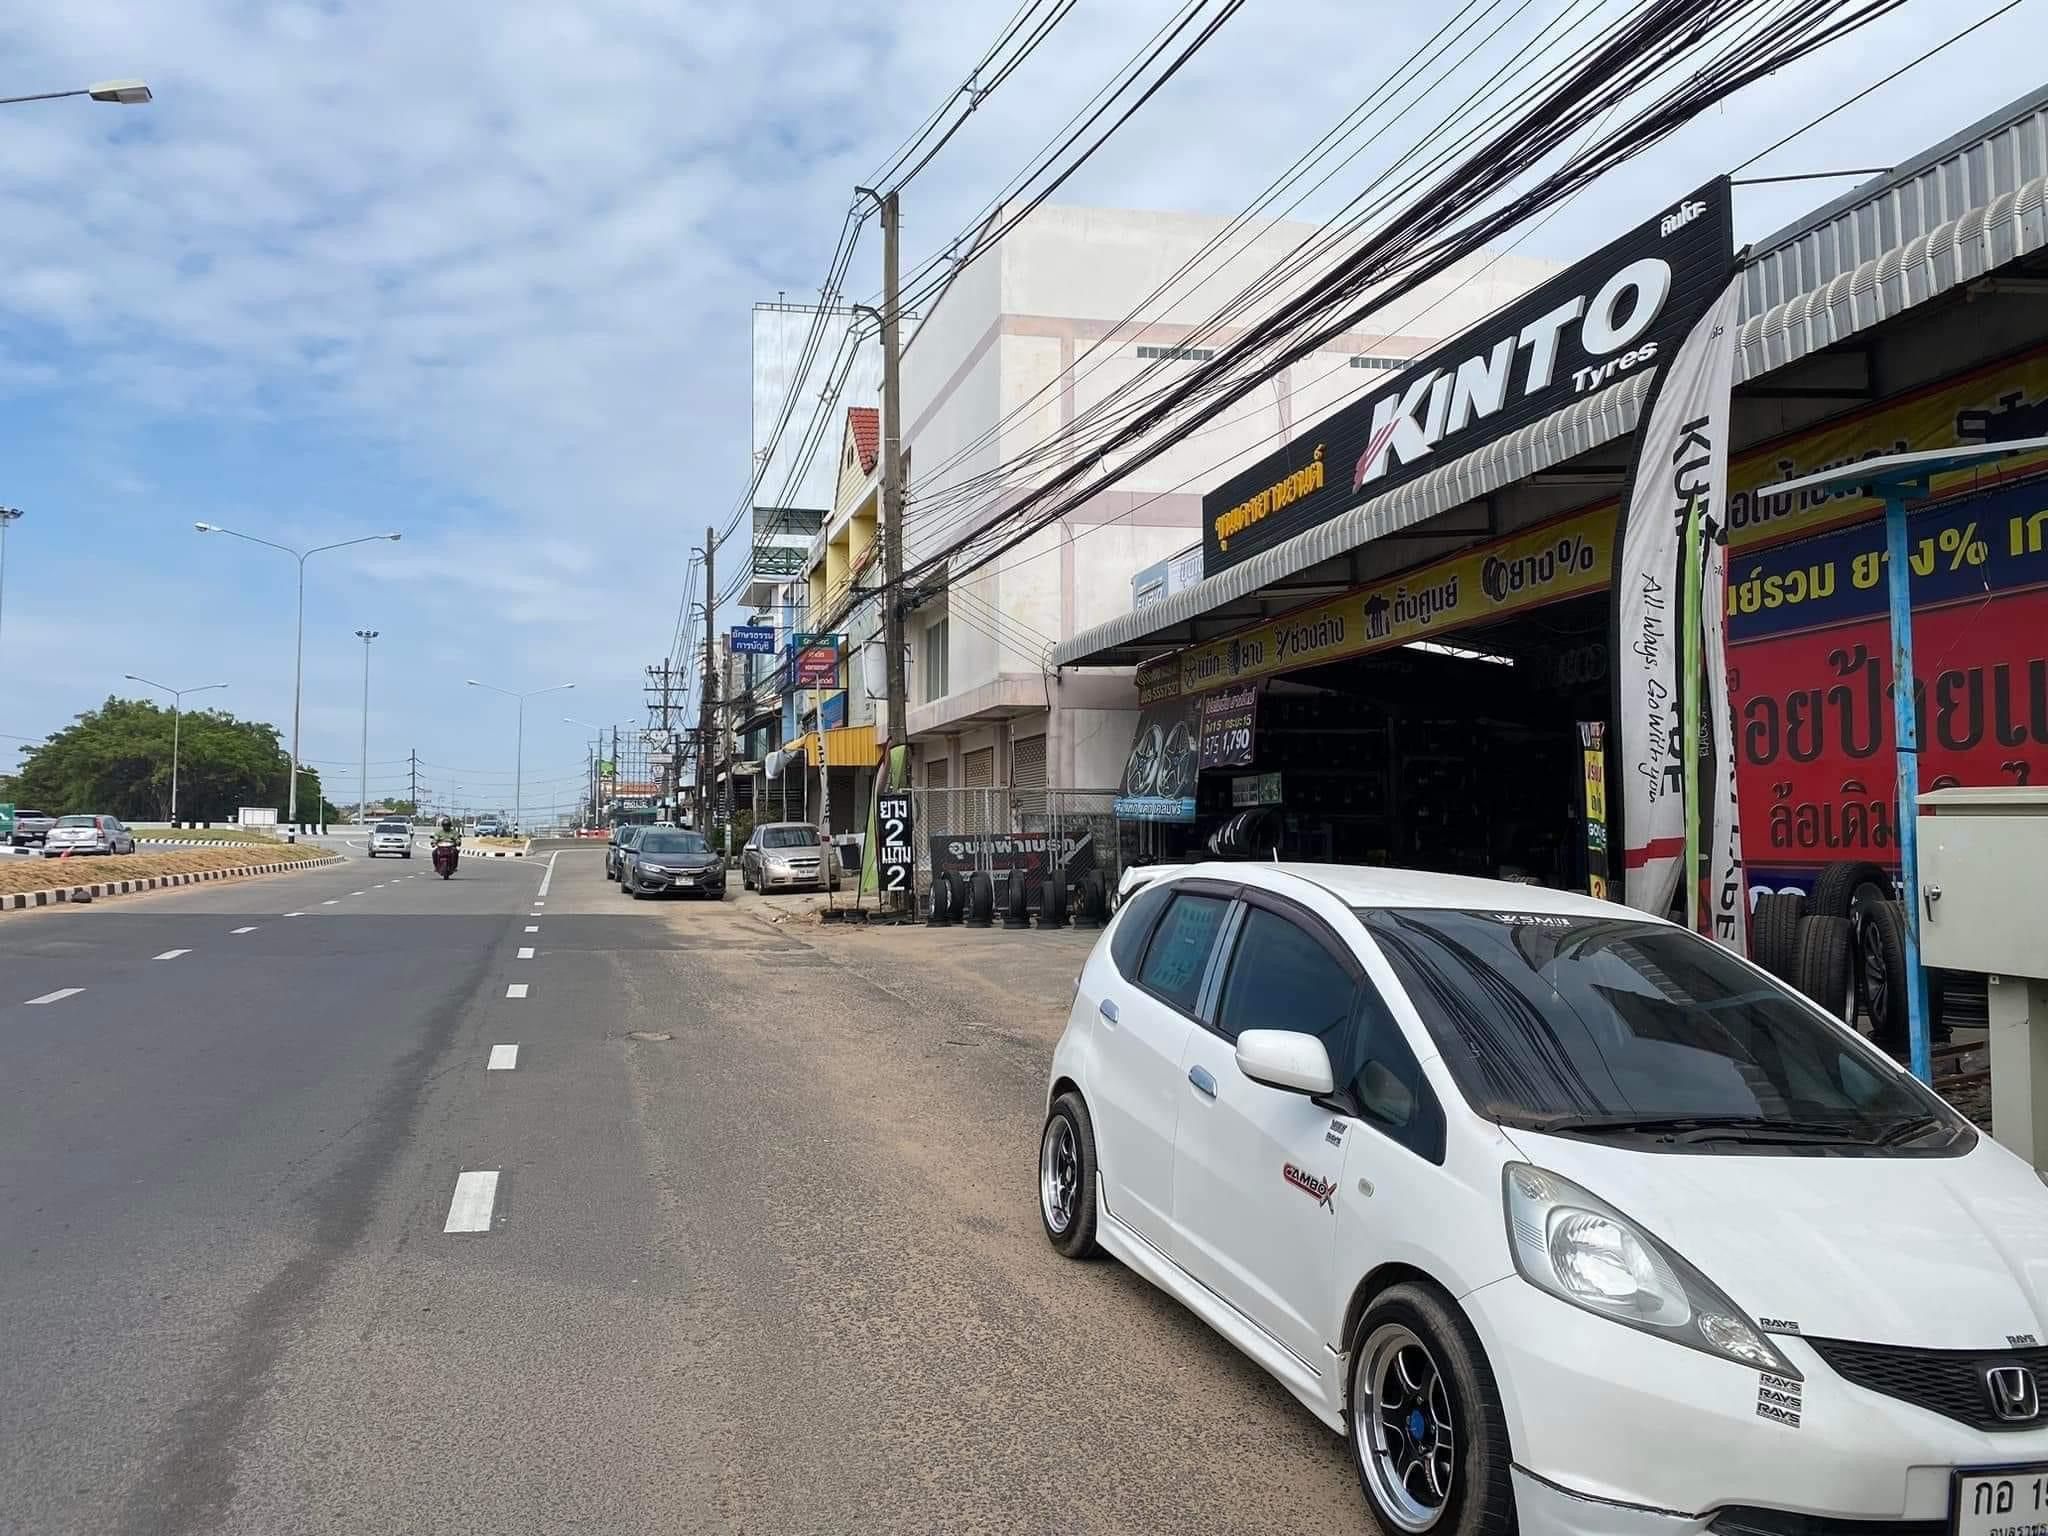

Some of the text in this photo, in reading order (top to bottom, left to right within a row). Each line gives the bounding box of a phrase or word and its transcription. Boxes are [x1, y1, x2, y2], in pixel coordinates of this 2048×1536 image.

[1352, 258, 1671, 494] KINTO
[1571, 342, 1658, 393] Tyres
[1394, 574, 1458, 625] ตั้งศูนย์
[1510, 534, 1594, 592] ยาง%
[880, 800, 907, 819] ยาง
[884, 819, 904, 847] 2
[887, 864, 906, 891] 2
[1760, 1317, 1799, 1330] RAYS
[1760, 1373, 1801, 1393] RAYS
[1760, 1388, 1801, 1408] RAYS
[1758, 1403, 1801, 1424] RAYS
[1975, 1481, 2014, 1515] กอ
